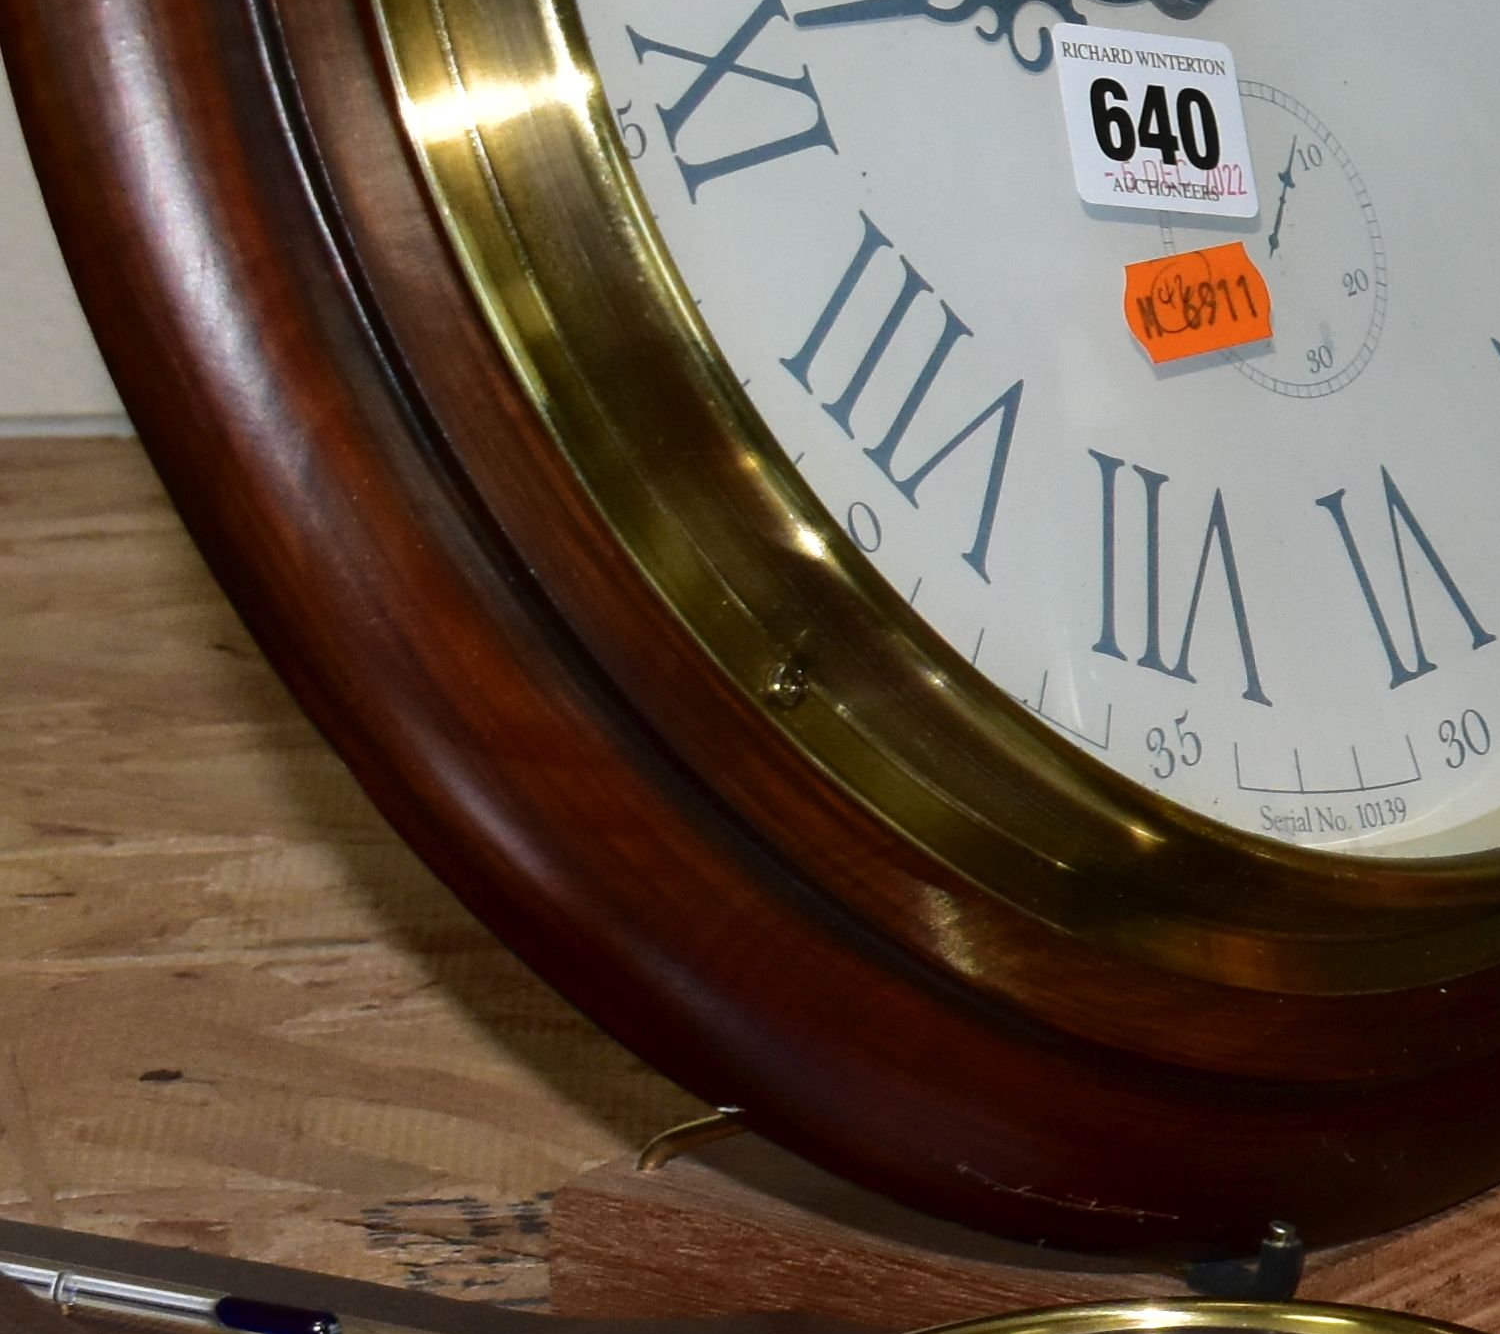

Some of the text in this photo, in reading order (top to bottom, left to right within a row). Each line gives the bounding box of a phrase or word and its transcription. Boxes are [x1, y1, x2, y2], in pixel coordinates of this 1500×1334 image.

[1062, 41, 1227, 76] RICHARD WINTERTON
[1089, 77, 1221, 170] 640
[1299, 143, 1323, 172] 10
[1114, 177, 1220, 202] AUCTIONEERS
[1343, 268, 1369, 297] 20
[1307, 344, 1334, 374] 30
[779, 209, 1024, 585] VIII
[1086, 448, 1273, 707] VII
[1315, 464, 1497, 690] VI
[1145, 710, 1203, 779] 35
[1437, 709, 1493, 770] 30
[1260, 797, 1407, 836] Serial No. 10139
